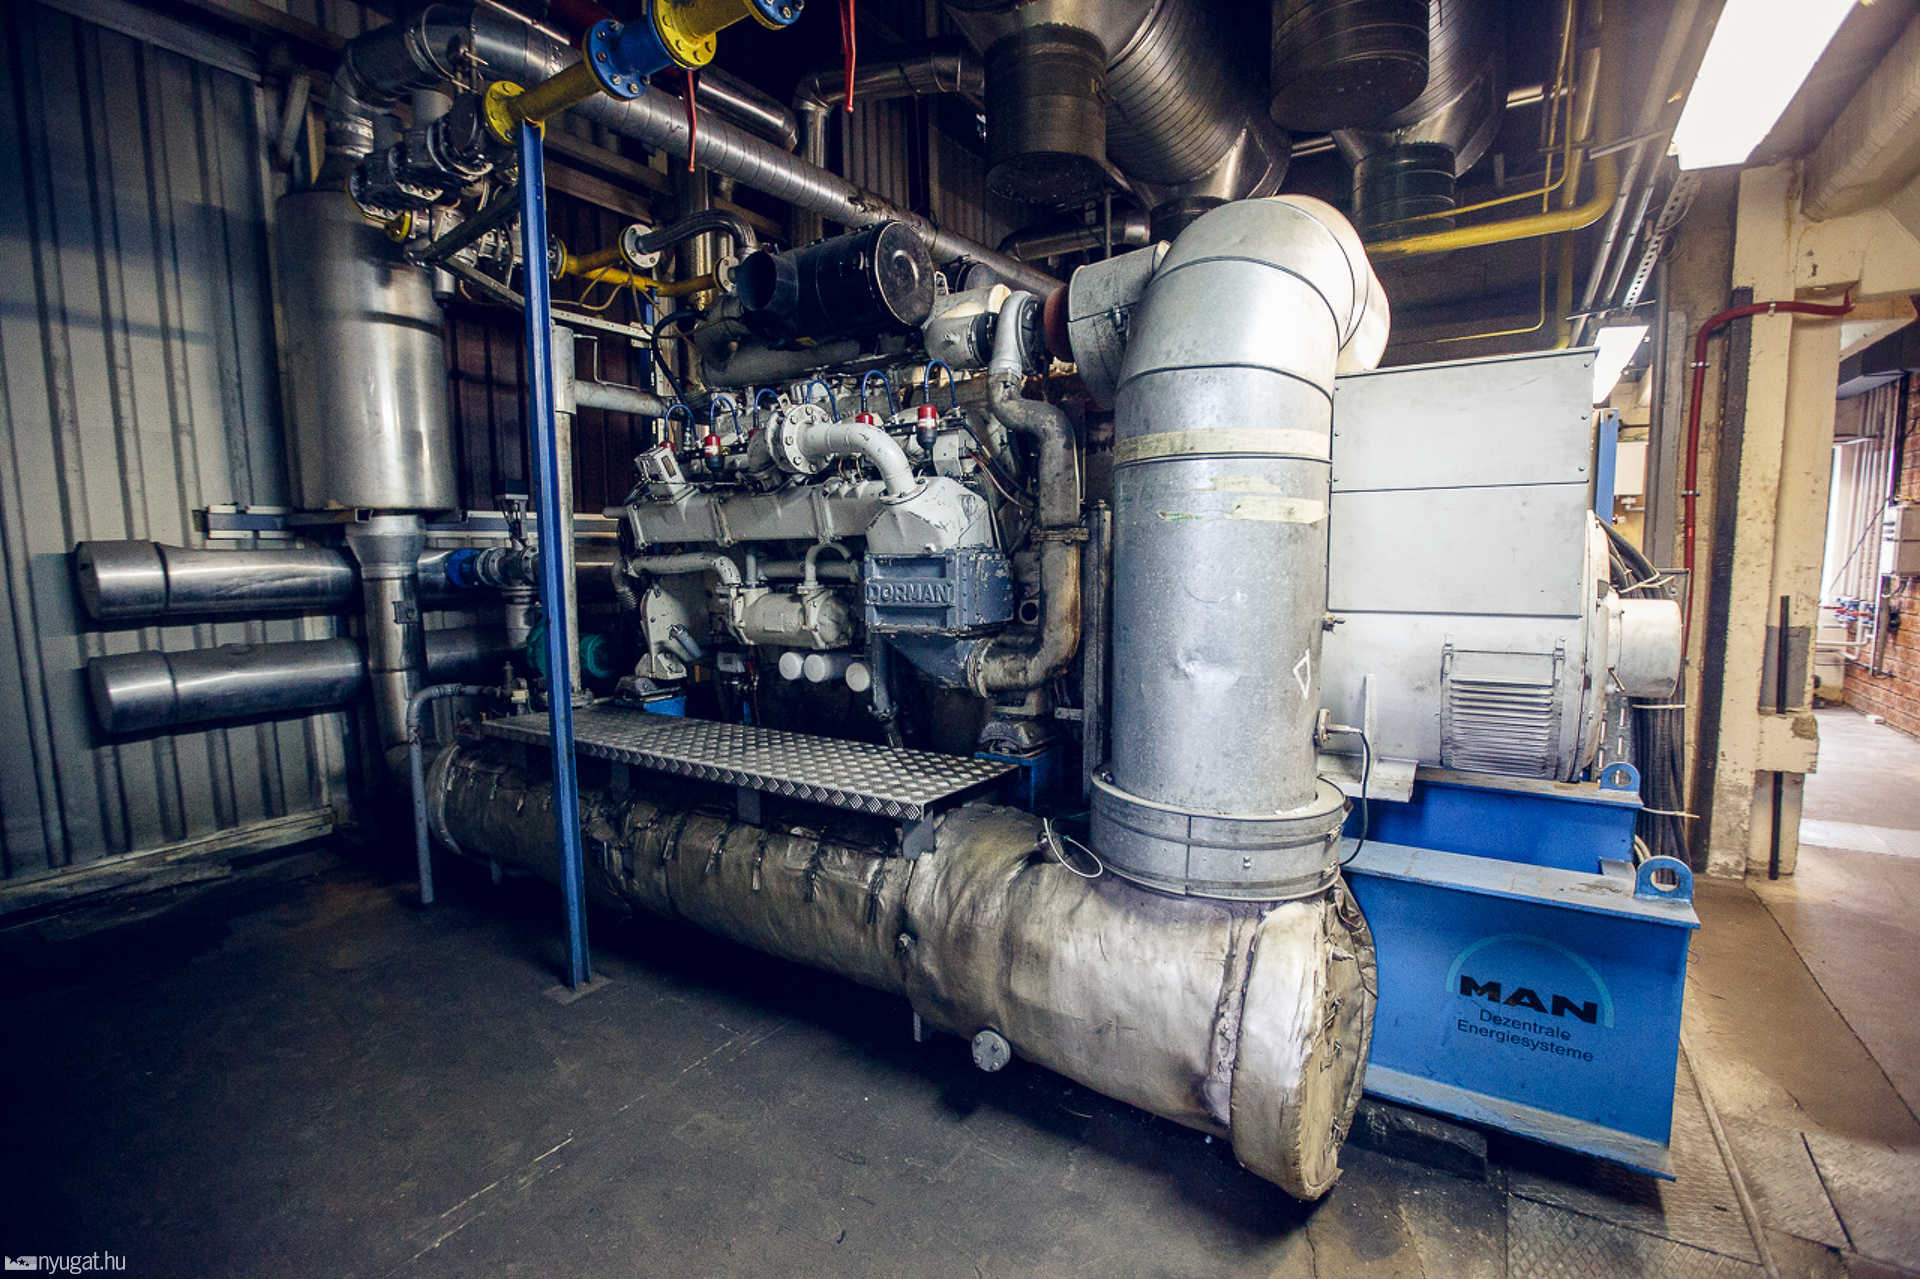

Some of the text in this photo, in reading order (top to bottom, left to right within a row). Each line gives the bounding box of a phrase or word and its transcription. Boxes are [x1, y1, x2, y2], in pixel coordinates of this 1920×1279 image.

[867, 582, 952, 603] DORMAN
[1460, 975, 1598, 1024] MAN
[1457, 1019, 1594, 1062] Energiesysteme
[1479, 1009, 1572, 1041] Dezentrale
